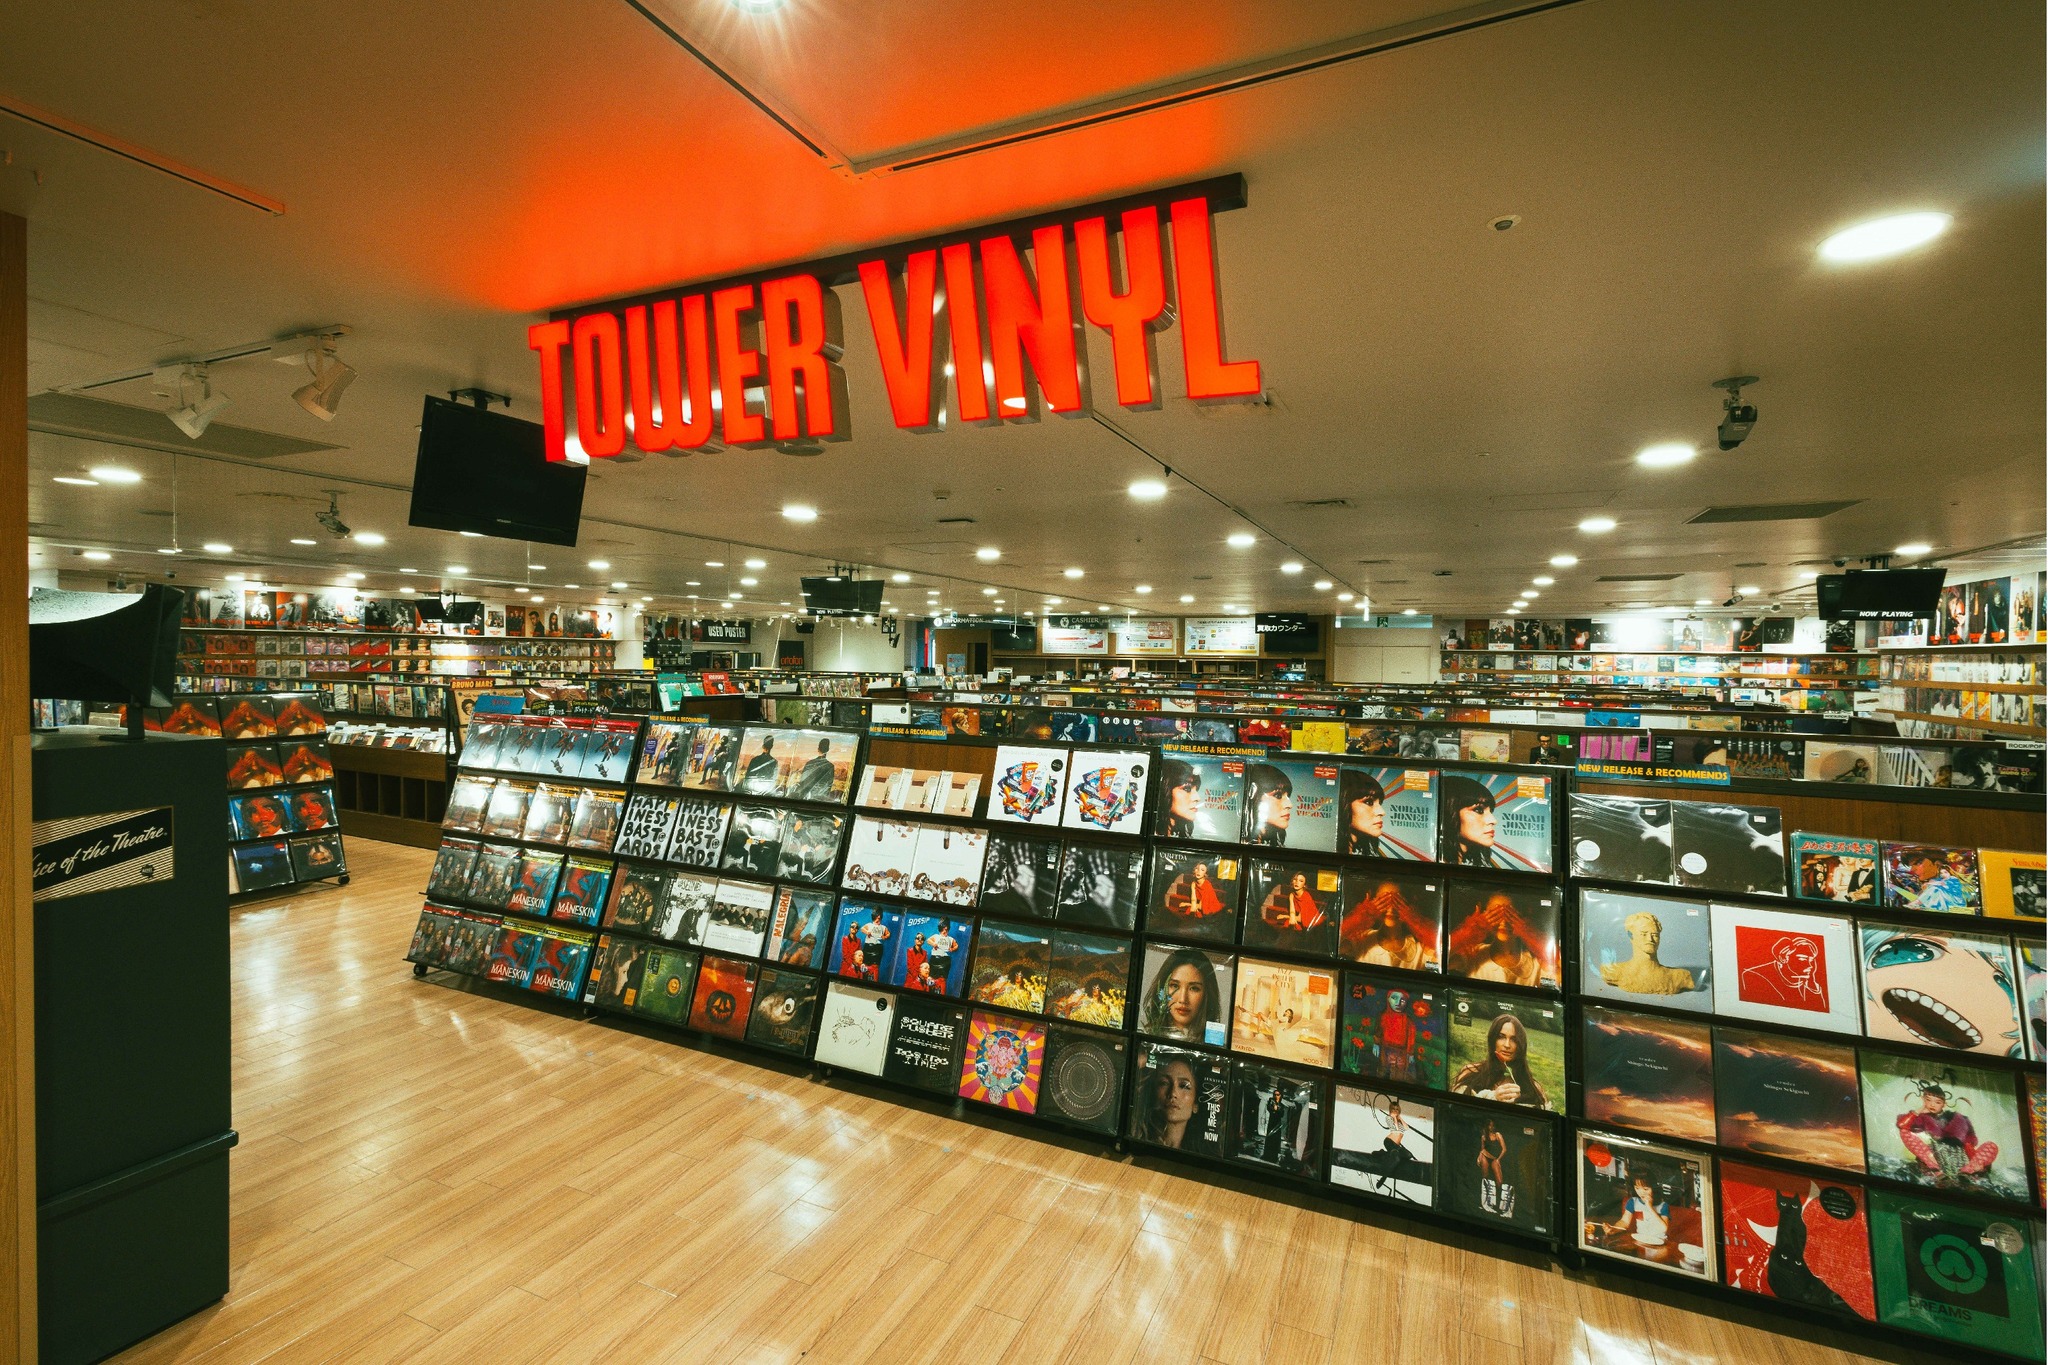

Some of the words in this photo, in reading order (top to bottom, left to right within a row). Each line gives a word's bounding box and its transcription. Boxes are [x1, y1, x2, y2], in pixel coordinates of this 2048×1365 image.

[529, 273, 834, 464] TOWER
[858, 197, 1261, 429] VINYL
[1881, 610, 1914, 618] PLAYING
[708, 625, 724, 637] USED
[724, 626, 746, 638] POSTER
[1256, 624, 1306, 632] 買取カウンター
[780, 656, 803, 666] ortofon
[451, 680, 474, 689] BRUNO
[475, 680, 494, 688] MARS
[870, 725, 882, 733] NEW
[882, 726, 904, 734] RELEASE
[909, 728, 946, 737] RECOMMENDS
[1163, 743, 1179, 752] NEW
[1180, 744, 1209, 754] RELEASE
[1209, 746, 1216, 754] &
[1216, 747, 1266, 757] RECOMMENDS
[1578, 763, 1601, 773] NEW
[1602, 765, 1644, 776] RELEASE
[1645, 768, 1653, 776] &
[1656, 768, 1728, 781] RECOMMENDS
[1390, 804, 1430, 815] NORAH
[627, 809, 670, 827] INESS
[679, 812, 723, 833] INESS
[1390, 812, 1429, 822] JONES
[1502, 812, 1546, 824] NORAH
[1390, 820, 1429, 829] VISIONS
[1502, 821, 1545, 832] JONES
[623, 821, 663, 842] BAST
[1502, 829, 1545, 839] VISIONS
[674, 827, 715, 850] BAST
[33, 853, 57, 878] ice
[60, 848, 82, 875] of
[81, 840, 110, 862] the
[111, 826, 165, 853] Theatre
[618, 838, 661, 859] ARDS
[671, 845, 715, 867] ARDS
[511, 892, 547, 909] MÅNESKIN
[557, 901, 597, 918] MÅNESKIN
[491, 963, 530, 981] MÅNESKIN
[535, 973, 575, 992] MÅNESKIN
[1644, 1063, 1669, 1071] Sekiguchi
[1783, 1086, 1810, 1096] Sekiguchi
[1206, 1102, 1221, 1113] THIS
[1209, 1111, 1216, 1120] IS
[1207, 1118, 1217, 1128] ME
[1204, 1131, 1219, 1142] NOW
[1908, 1297, 1972, 1321] DREAMS
